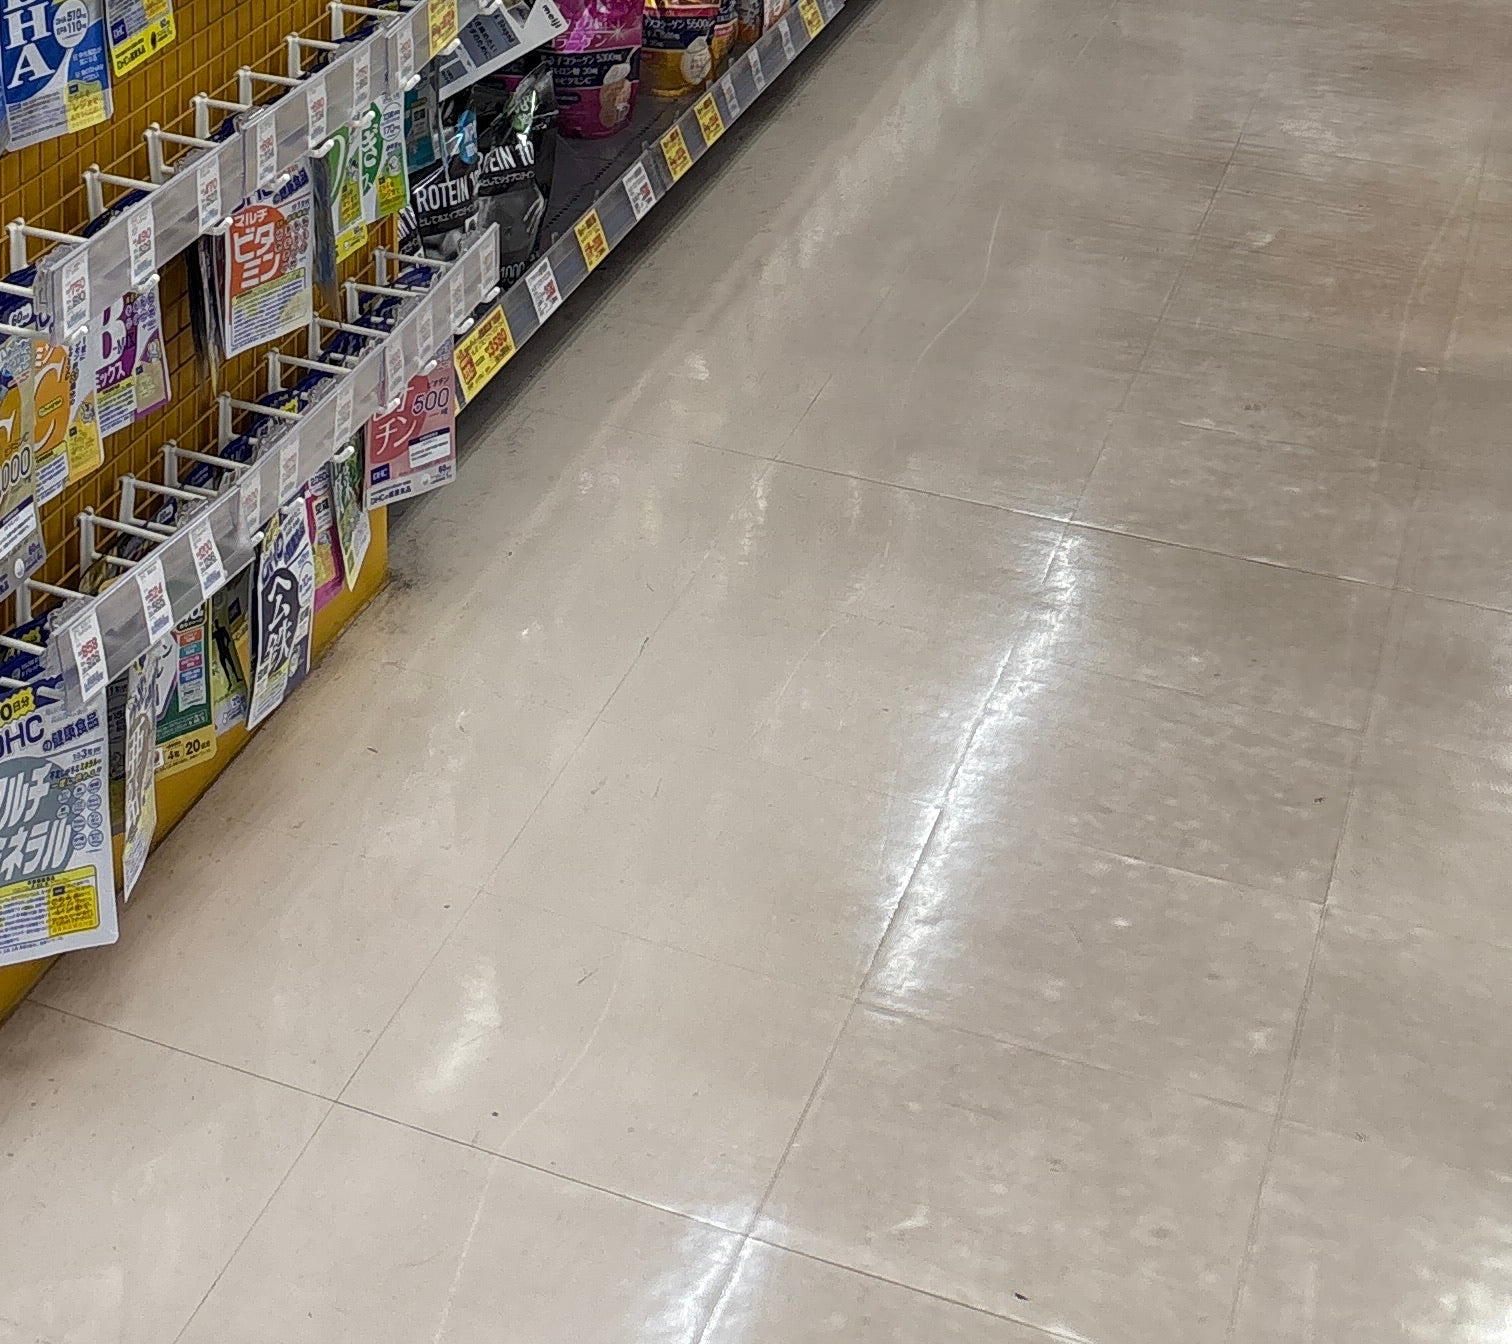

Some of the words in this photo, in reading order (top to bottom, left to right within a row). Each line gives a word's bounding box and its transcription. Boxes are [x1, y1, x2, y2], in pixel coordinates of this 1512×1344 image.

[234, 209, 267, 228] マルチ
[412, 388, 450, 415] 500
